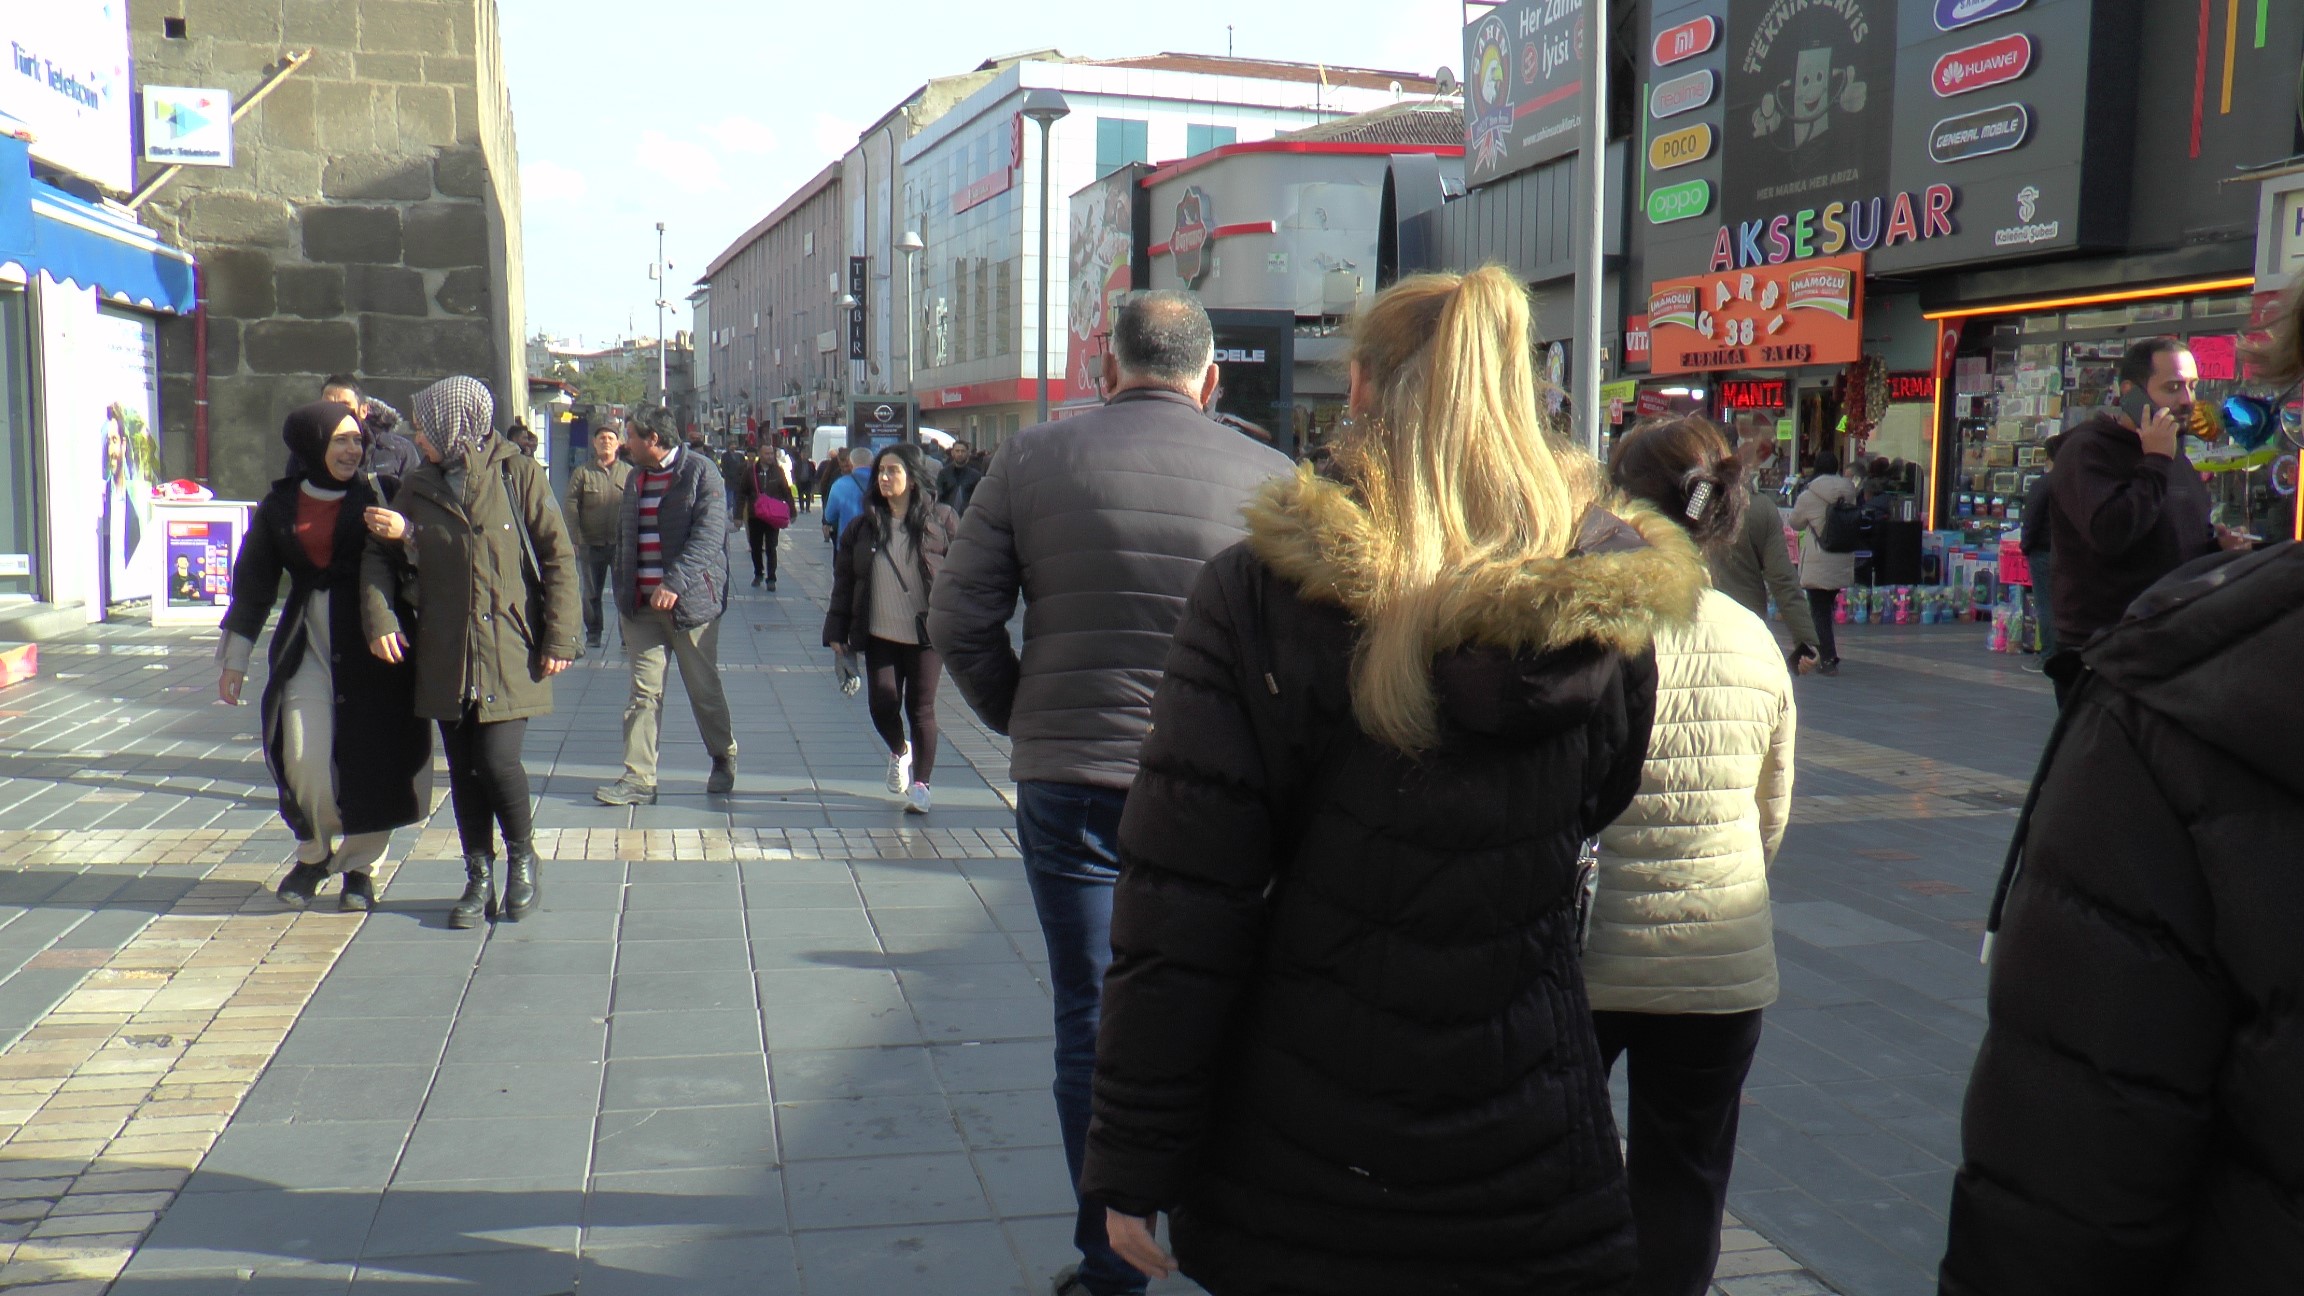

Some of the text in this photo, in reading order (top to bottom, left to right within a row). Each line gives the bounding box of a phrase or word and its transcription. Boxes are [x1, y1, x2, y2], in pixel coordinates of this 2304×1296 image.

[1520, 7, 1542, 39] Her
[11, 40, 98, 110] Türk Telekom
[1965, 50, 2018, 77] HUAWEI
[1660, 82, 1705, 108] realme
[1663, 134, 1697, 159] POCO
[1936, 118, 2019, 148] GENERAL MOBILE
[1655, 188, 1702, 216] oppo
[1756, 186, 1774, 201] HER
[1775, 180, 1807, 197] MARKA
[1809, 175, 1828, 190] HER
[1709, 182, 1953, 272] AKSESUAR
[853, 262, 862, 354] TEKBİR
[1725, 318, 1754, 346] 38
[1213, 349, 1265, 362] DELE
[1722, 382, 1784, 407] MANTI
